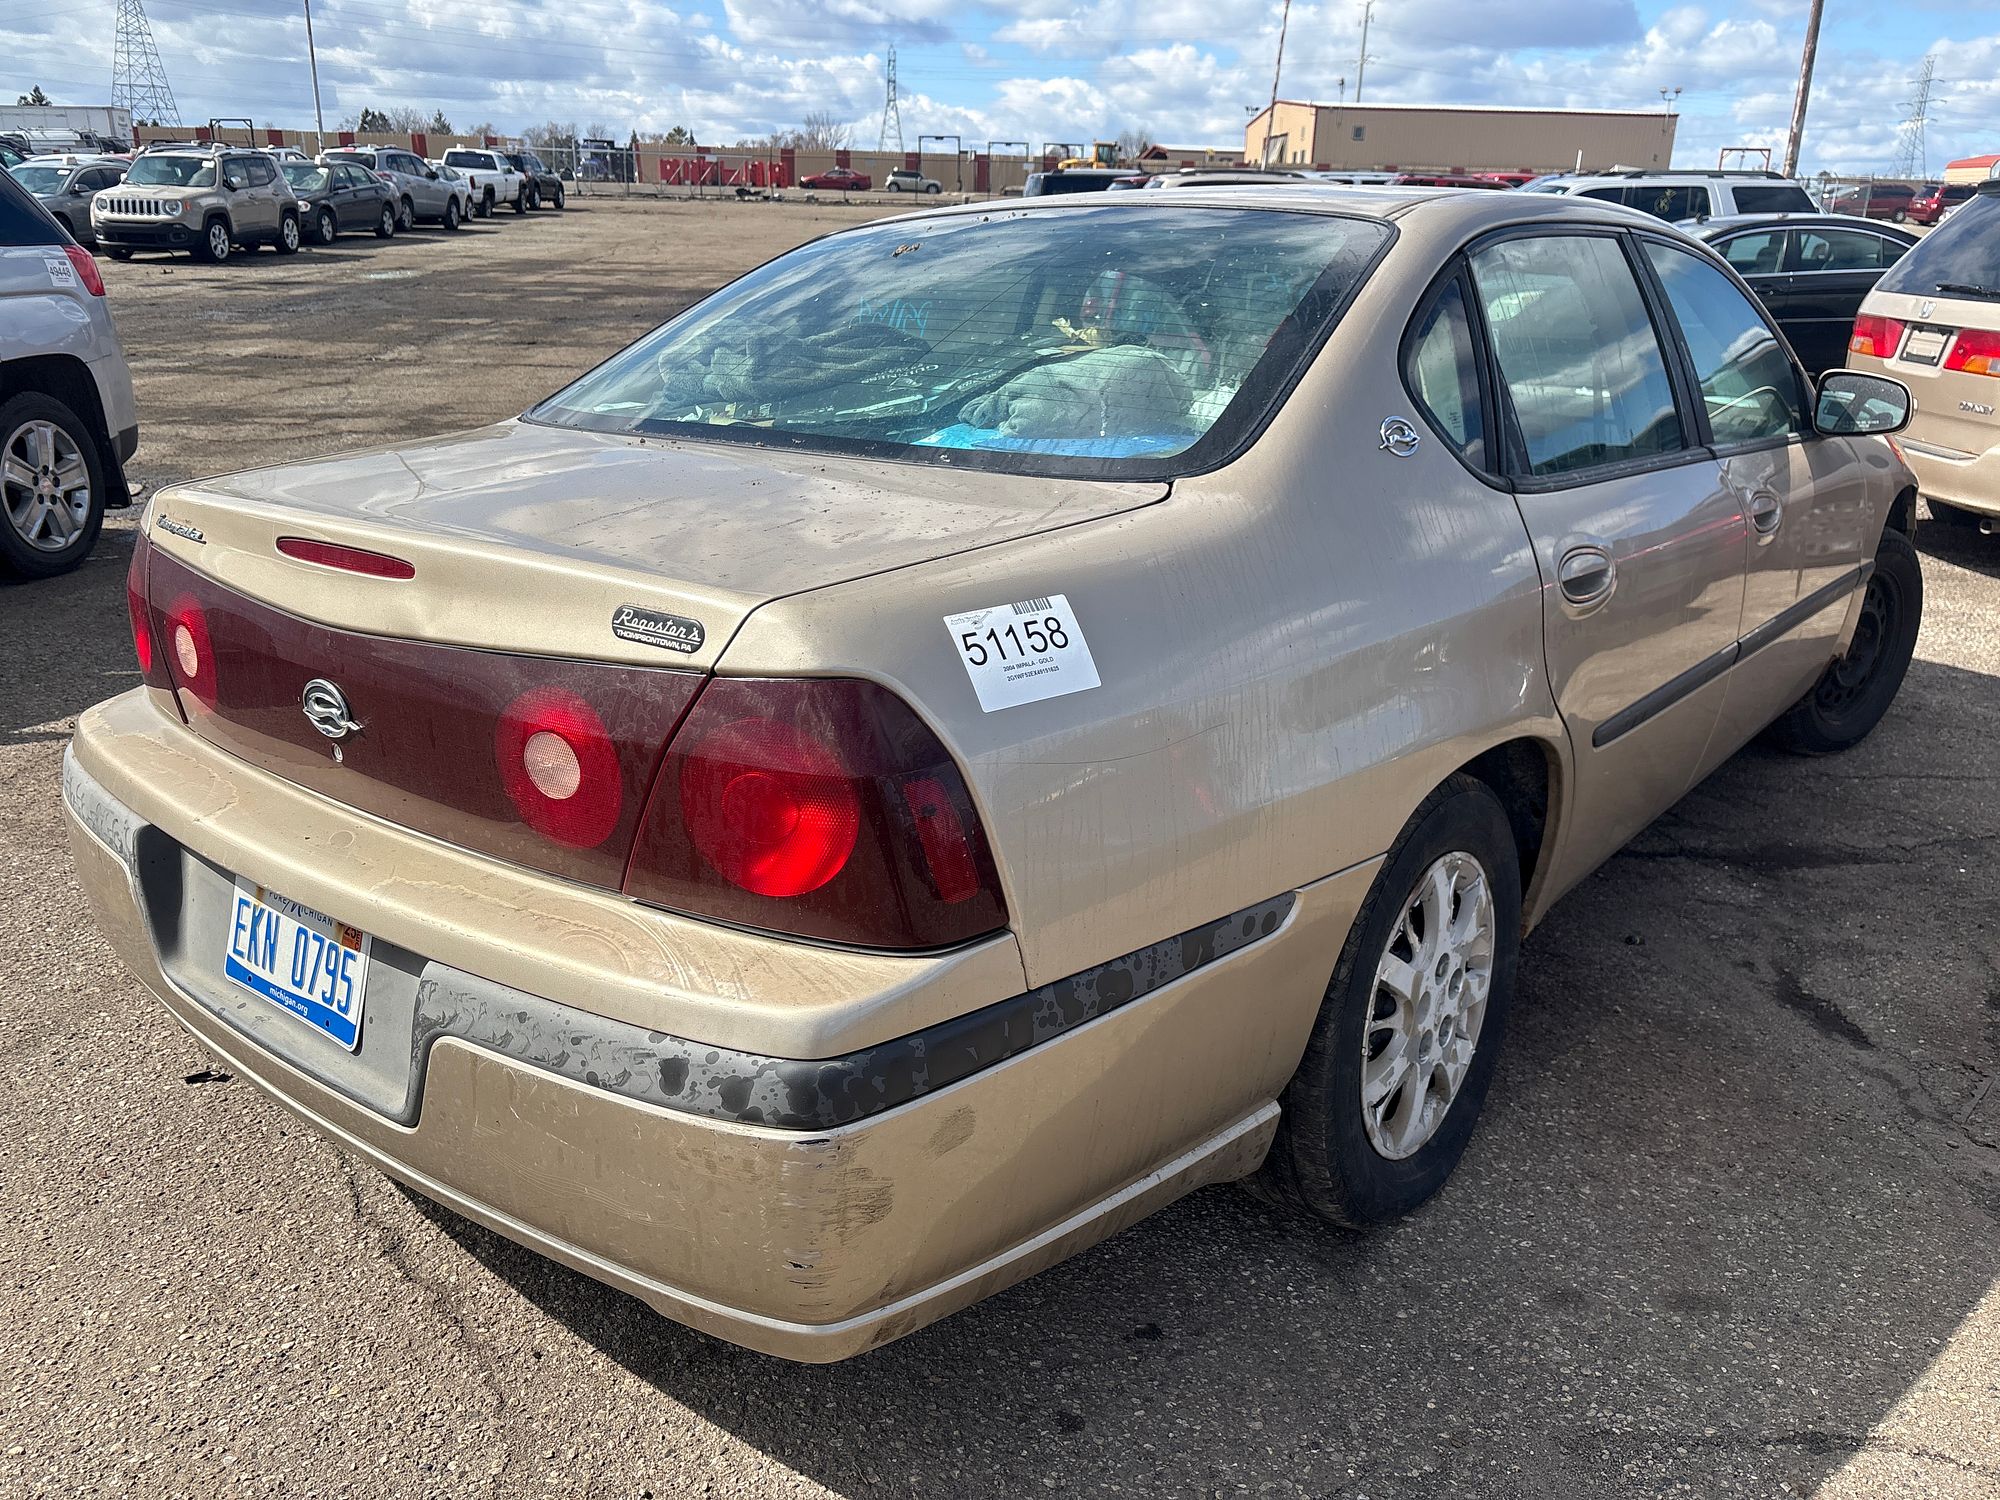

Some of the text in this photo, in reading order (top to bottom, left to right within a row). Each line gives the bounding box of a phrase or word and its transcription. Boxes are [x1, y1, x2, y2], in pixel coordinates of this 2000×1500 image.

[616, 629, 692, 652] THOMPSONTOWN, PA
[961, 616, 1069, 666] 51158
[1015, 660, 1036, 669] IMPALA
[1038, 656, 1054, 665] GOLD
[232, 897, 358, 1016] EKN 0795
[269, 986, 309, 1017] michigan.org
